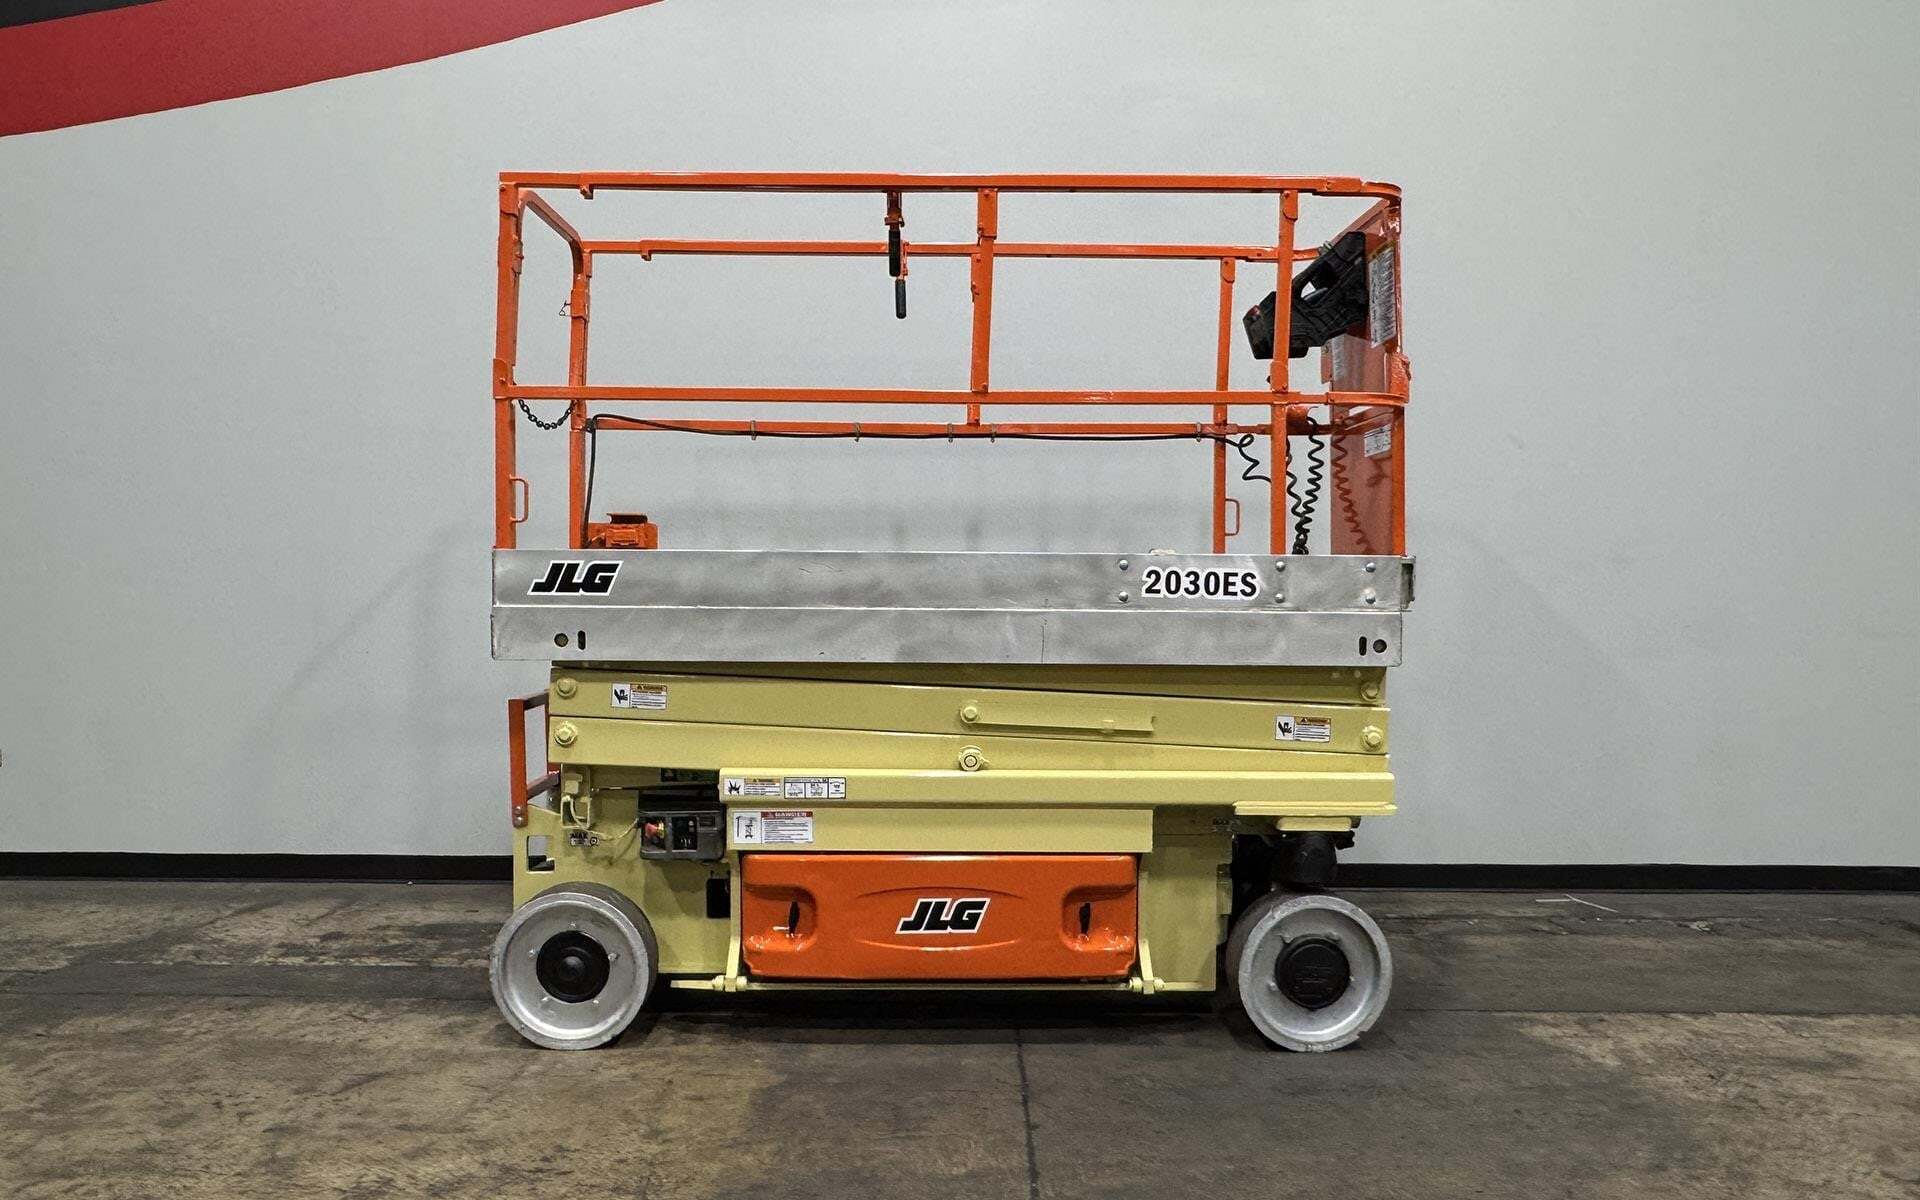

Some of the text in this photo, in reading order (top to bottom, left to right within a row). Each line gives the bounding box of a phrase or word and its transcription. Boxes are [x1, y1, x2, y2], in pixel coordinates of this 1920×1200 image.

[529, 562, 621, 594] JLG
[1143, 568, 1258, 598] 2030ES
[898, 899, 989, 932] JLG
